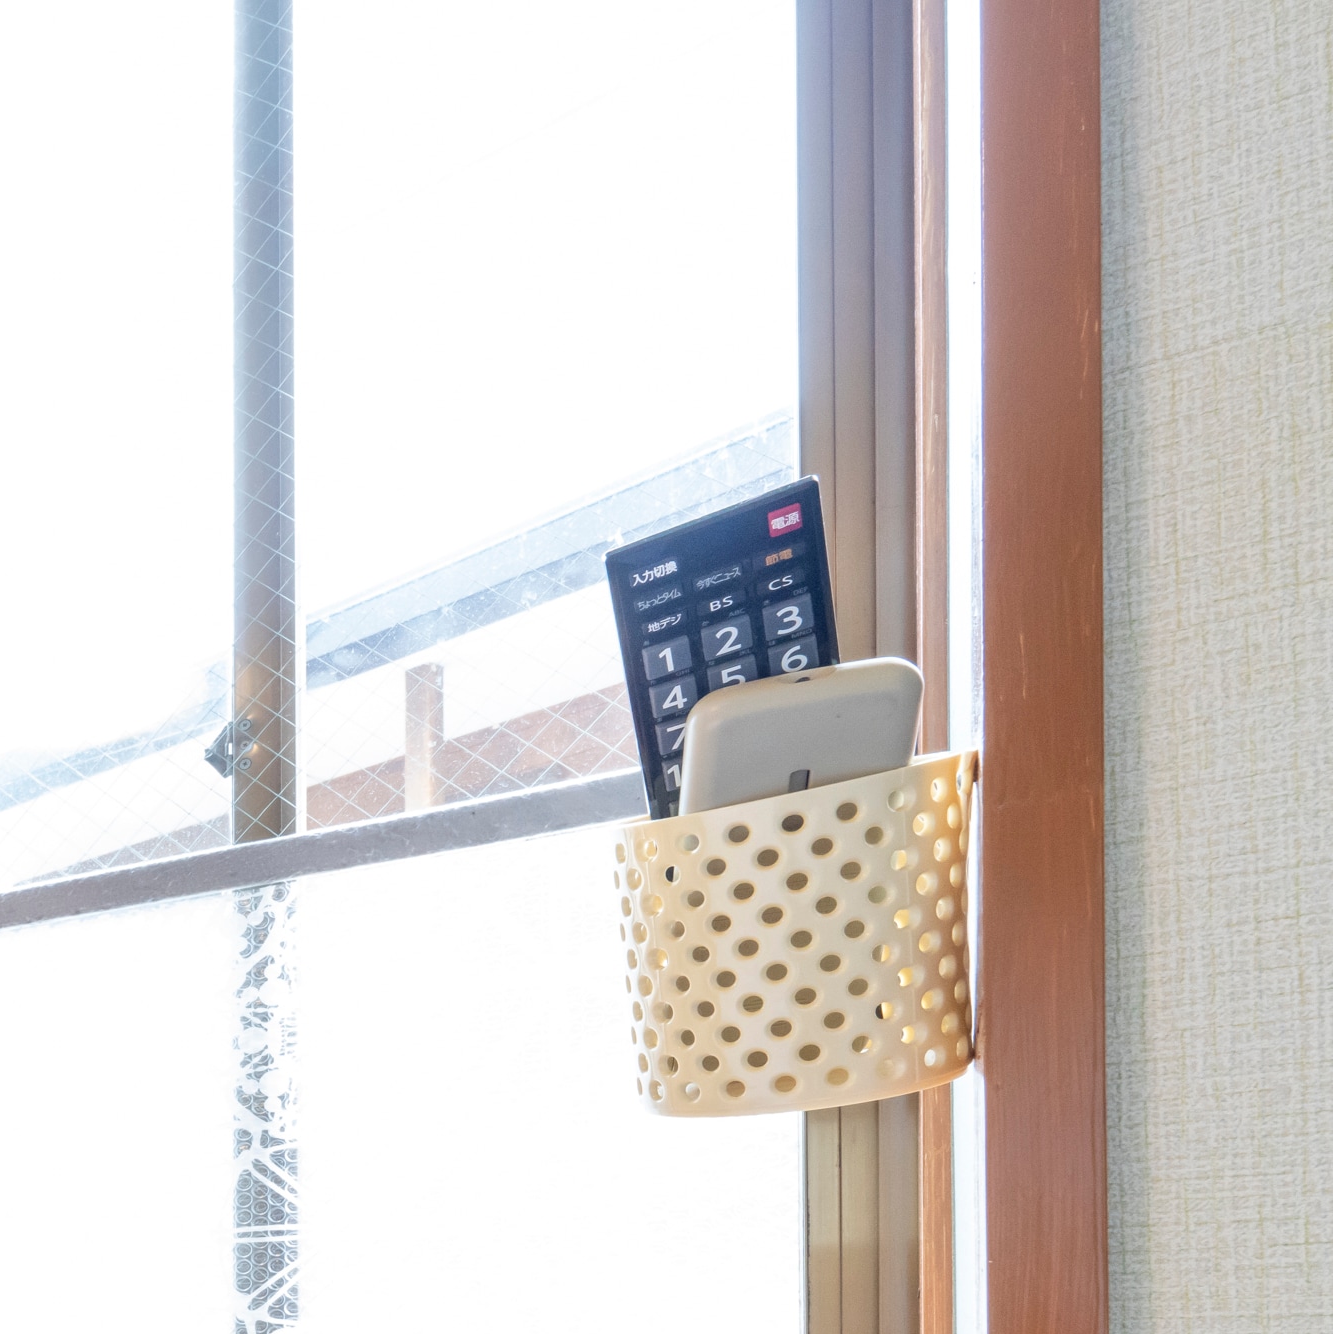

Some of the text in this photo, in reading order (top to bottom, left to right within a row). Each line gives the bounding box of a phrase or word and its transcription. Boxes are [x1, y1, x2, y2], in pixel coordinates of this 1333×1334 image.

[770, 510, 801, 530] 電源
[768, 575, 793, 591] CS
[709, 595, 733, 612] BS
[647, 613, 682, 633] 地デジ
[776, 605, 803, 635] 3
[715, 626, 742, 656] 2
[658, 647, 675, 672] 1
[781, 645, 808, 673] 6
[721, 665, 746, 685] 5
[663, 685, 687, 710] 4
[666, 723, 686, 750] 7
